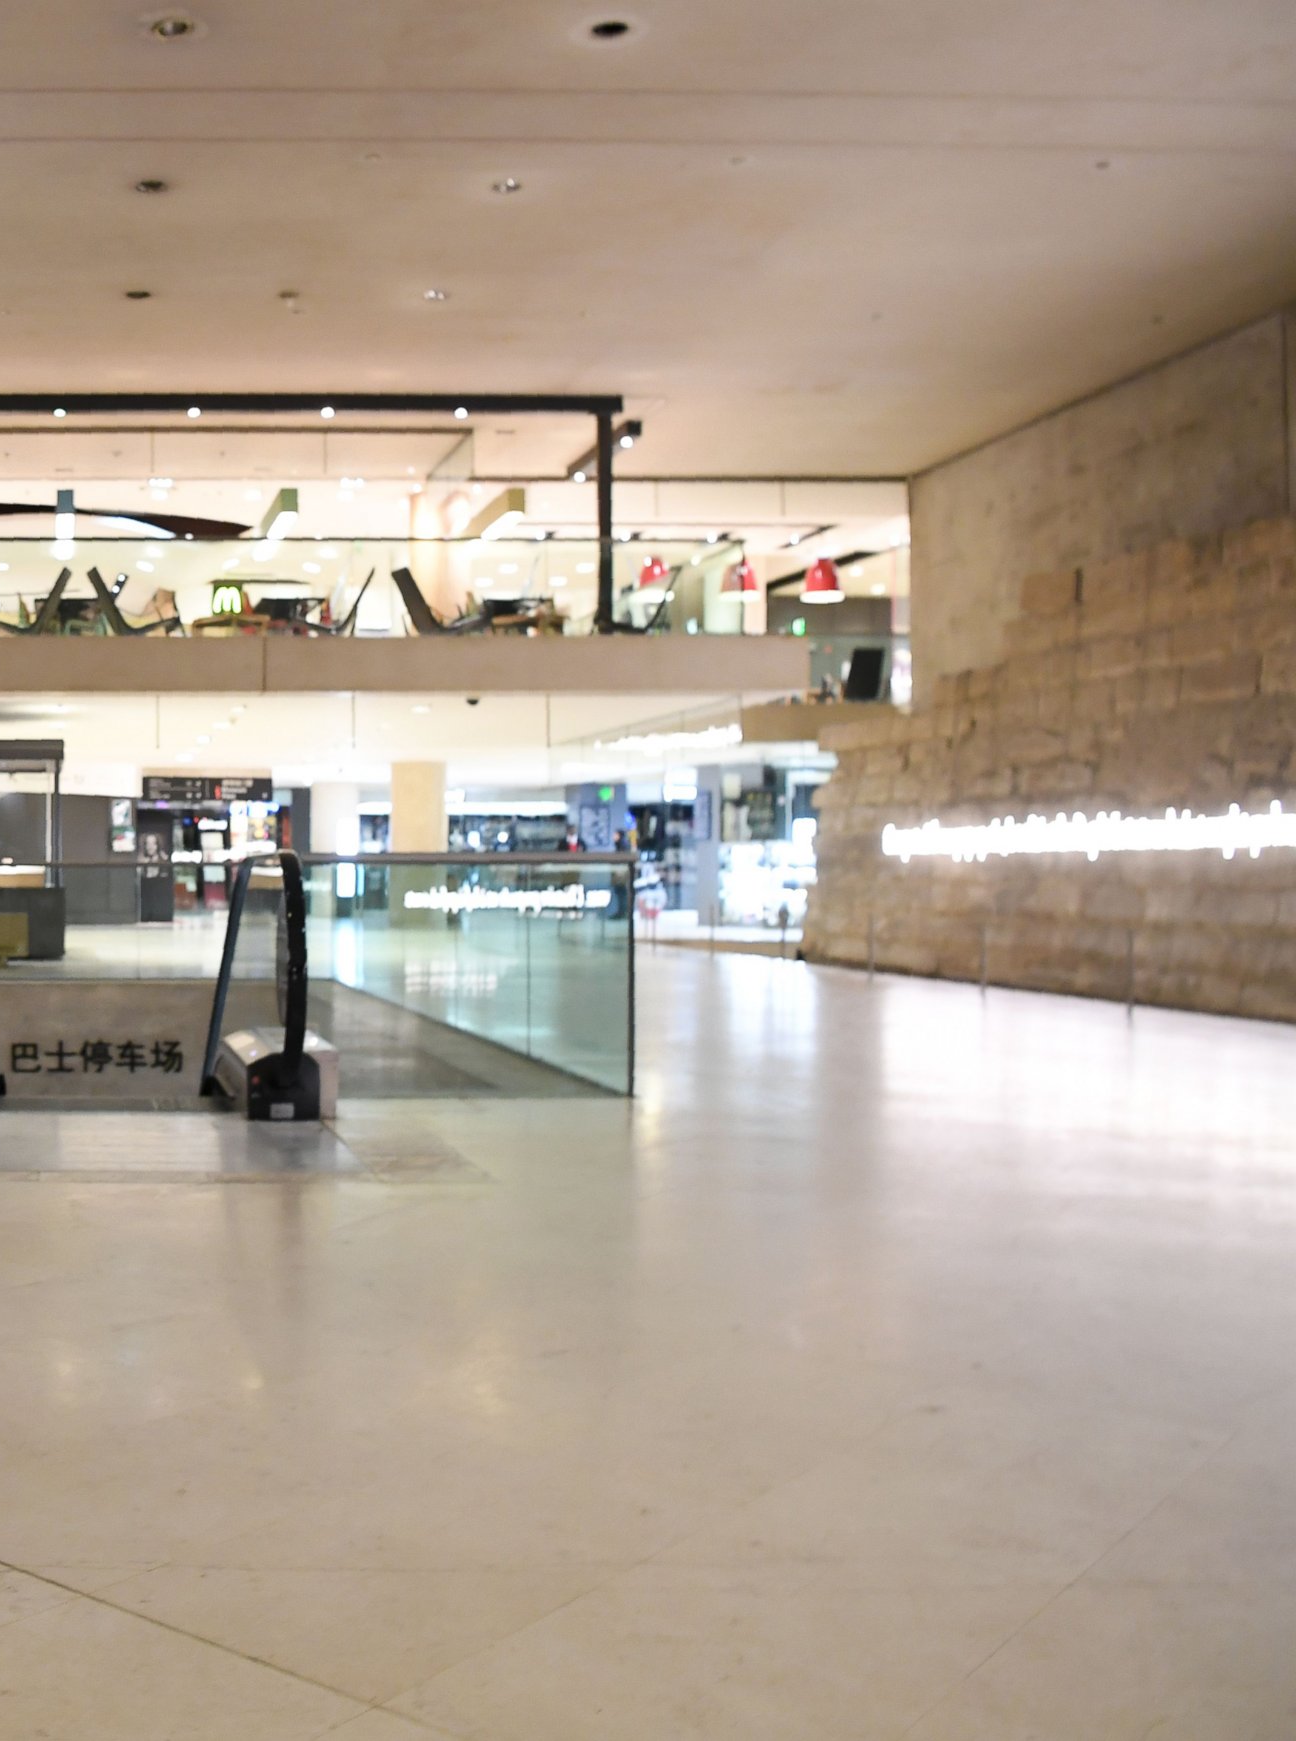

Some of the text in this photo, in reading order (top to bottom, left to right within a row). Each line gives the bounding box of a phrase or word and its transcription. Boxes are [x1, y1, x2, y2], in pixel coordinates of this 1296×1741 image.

[10, 1039, 183, 1073] 巴士停车场
